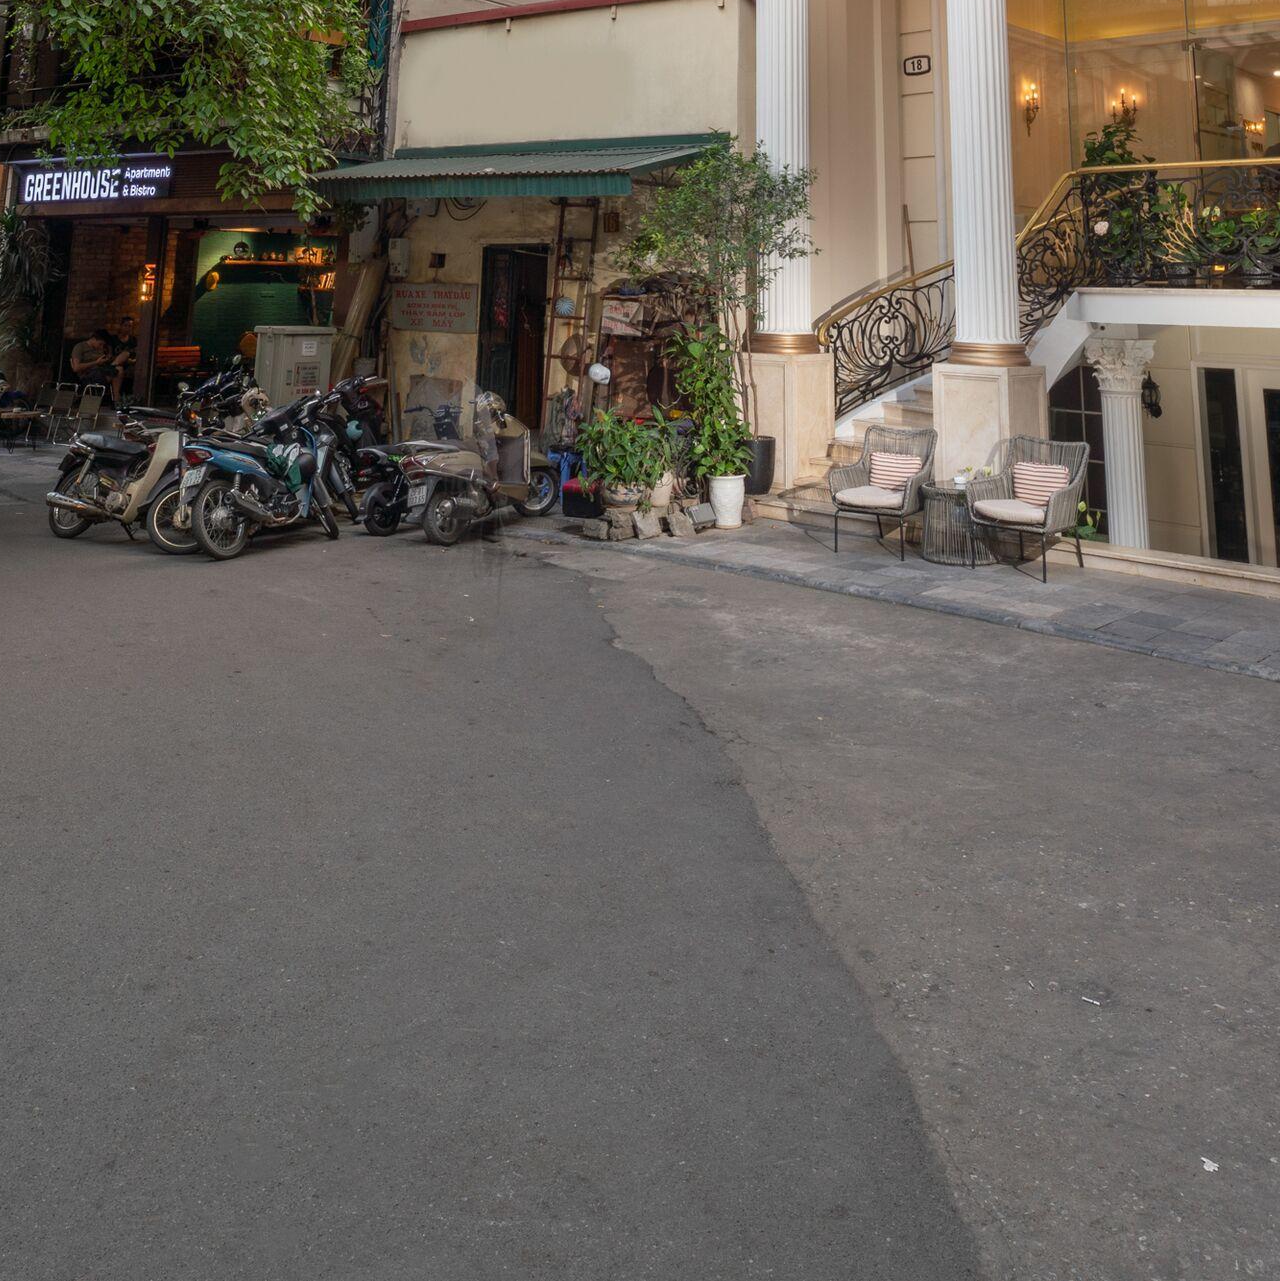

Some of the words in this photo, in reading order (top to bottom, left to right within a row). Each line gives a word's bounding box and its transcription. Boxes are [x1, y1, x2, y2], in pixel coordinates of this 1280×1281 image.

[910, 59, 923, 72] 18
[25, 169, 120, 202] GREENHOUSE
[125, 166, 171, 182] Apartment
[130, 184, 156, 196] Bistro
